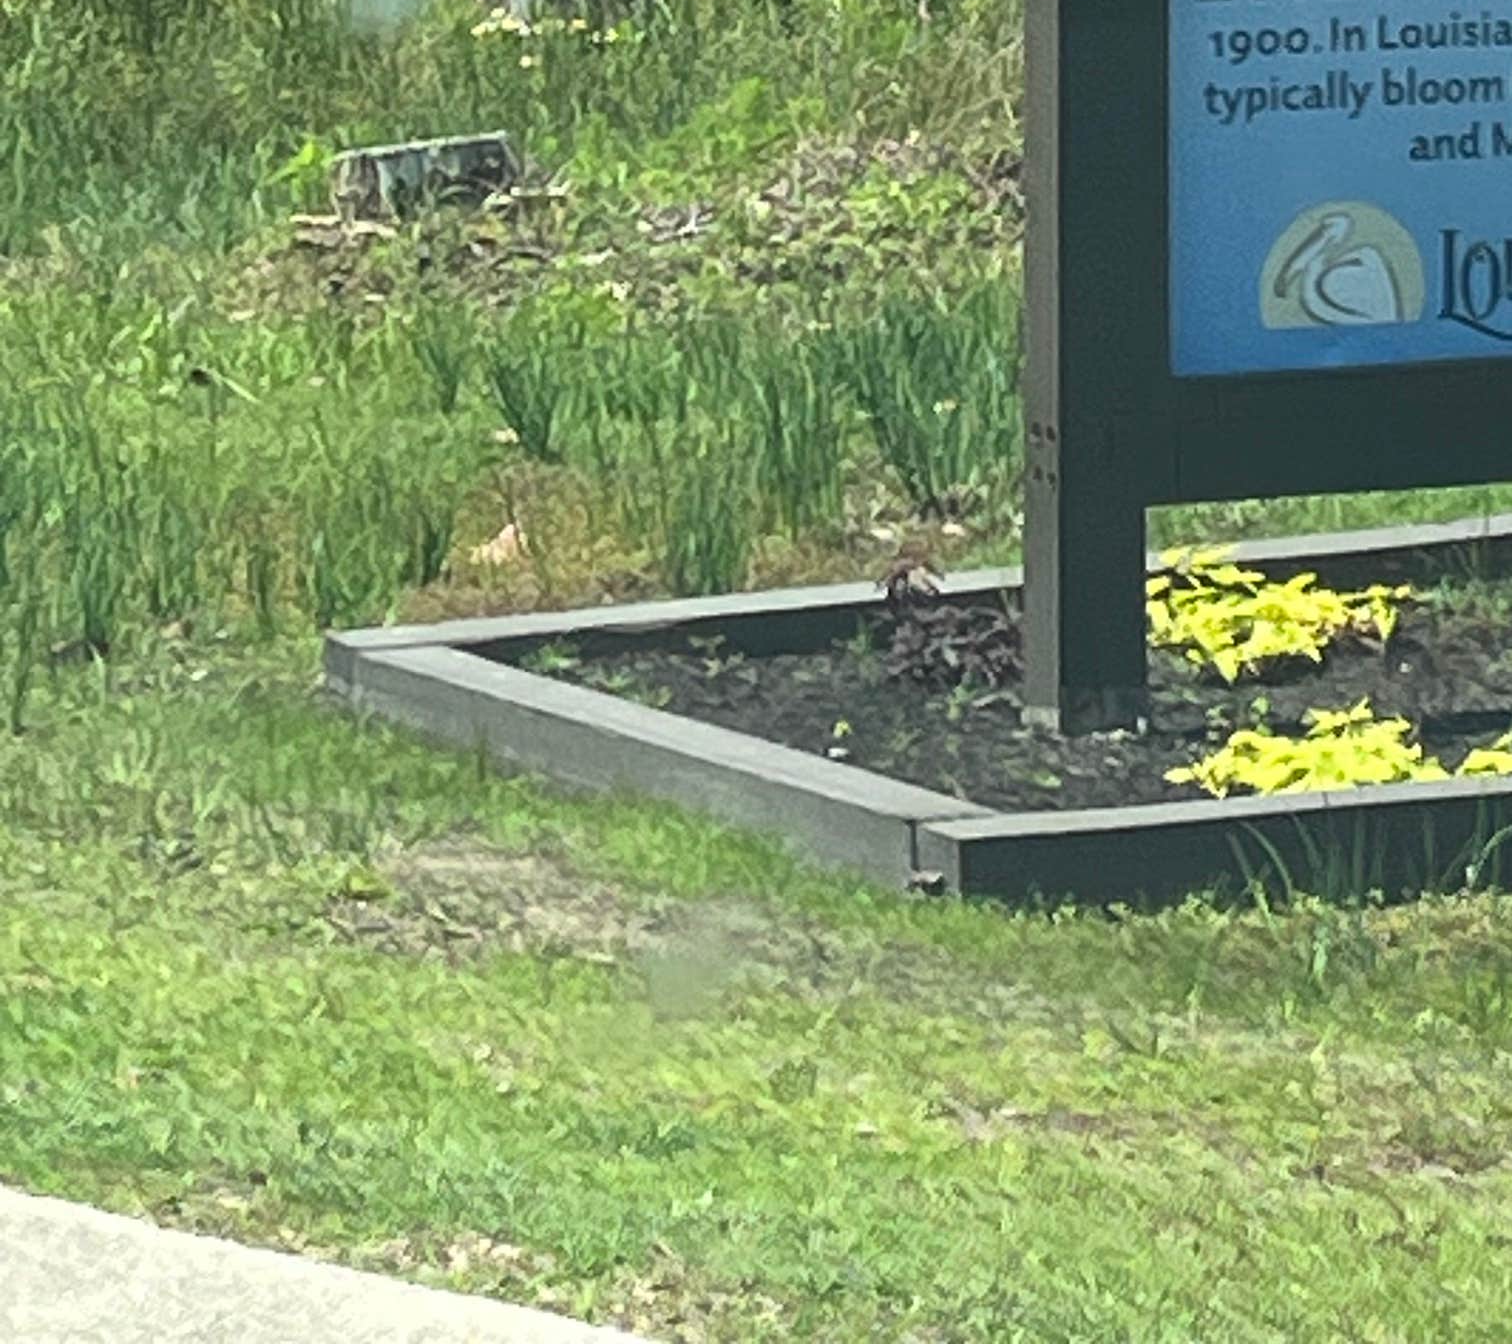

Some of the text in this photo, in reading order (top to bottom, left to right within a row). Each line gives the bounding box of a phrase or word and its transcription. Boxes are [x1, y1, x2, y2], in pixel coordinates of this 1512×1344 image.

[1210, 28, 1323, 64] 1900.
[1330, 17, 1367, 53] In
[1203, 70, 1373, 125] typically
[1382, 68, 1501, 106] bloom
[1409, 124, 1481, 162] and
